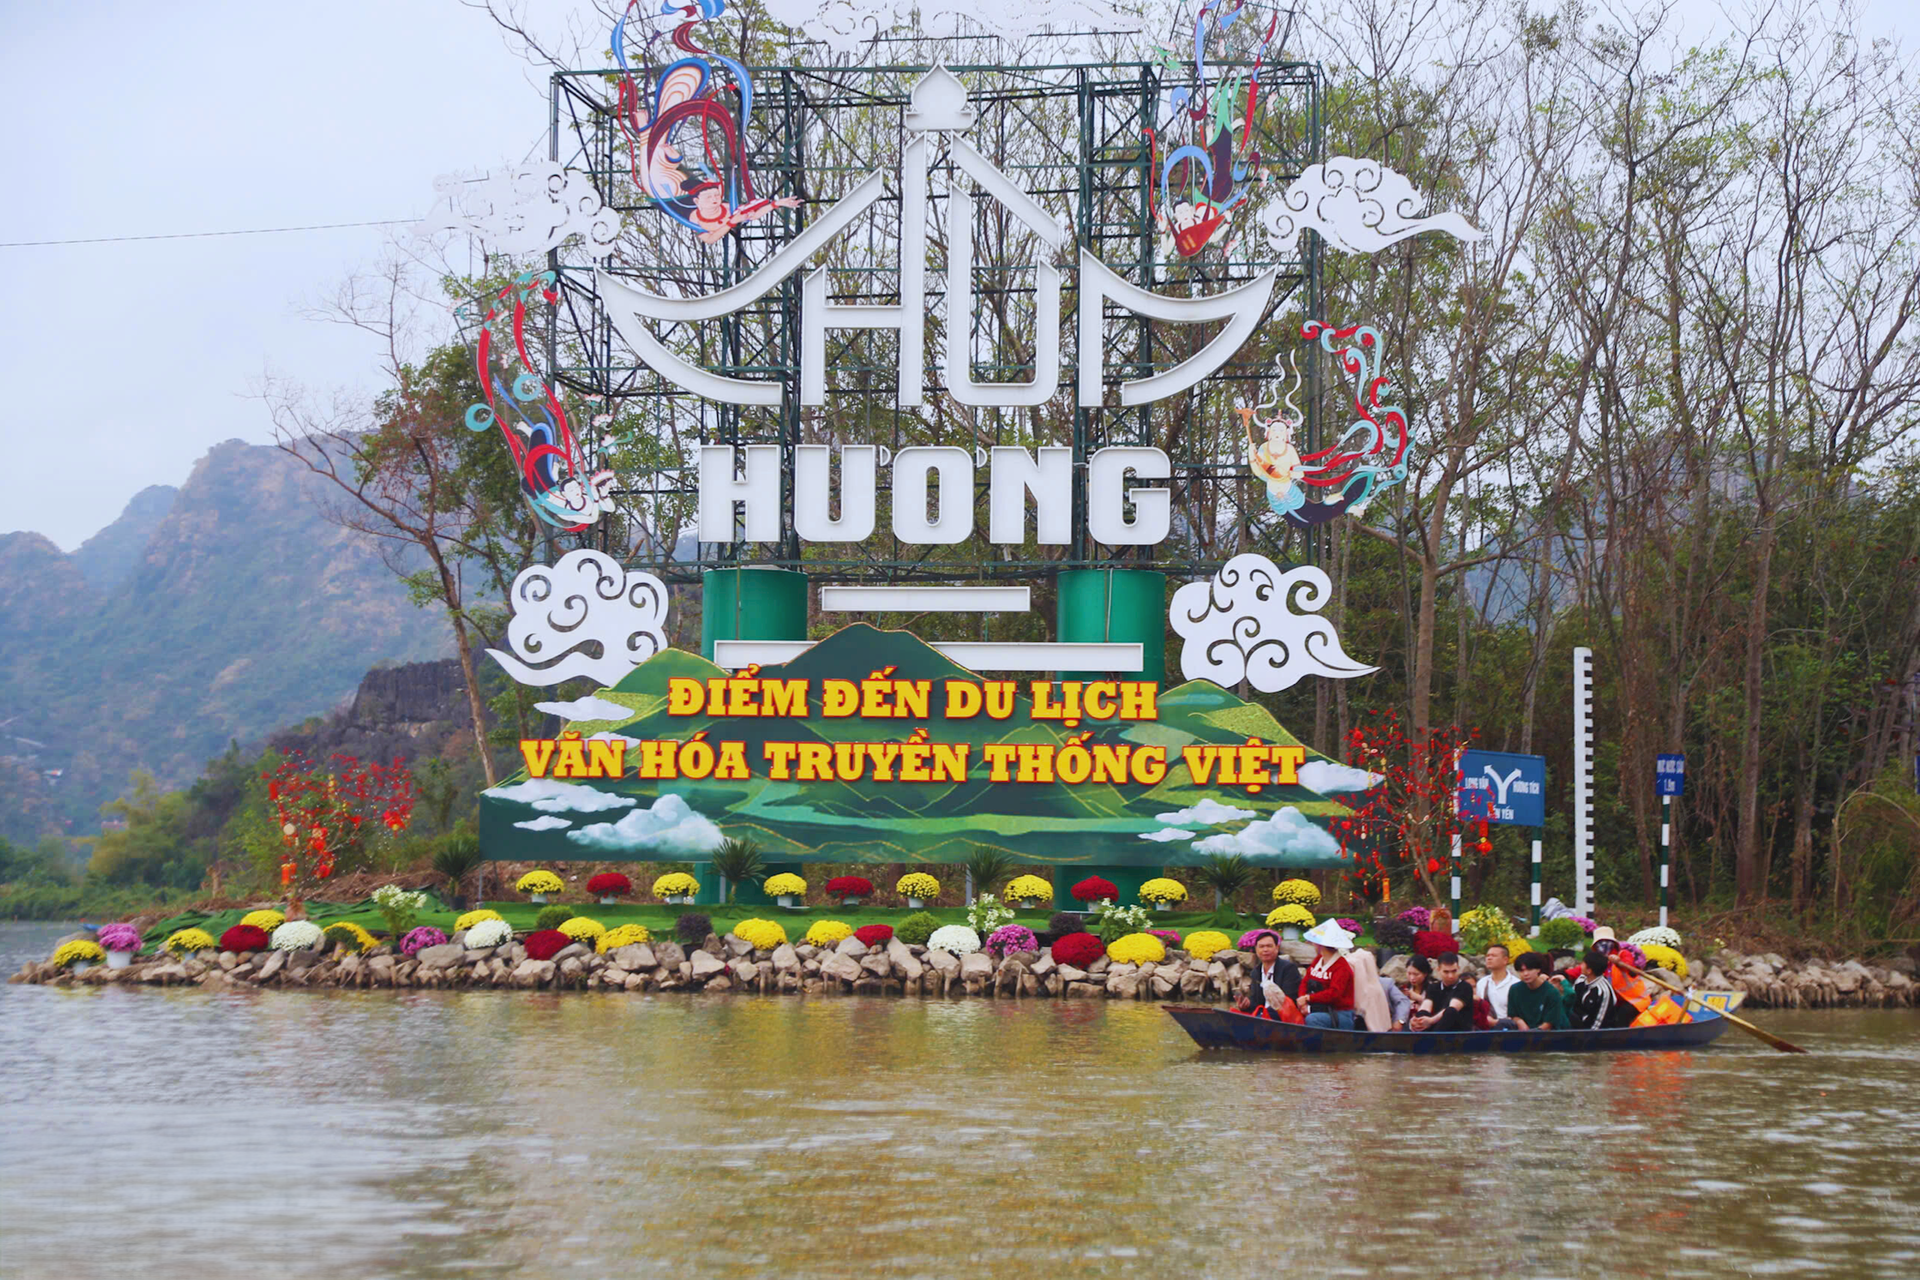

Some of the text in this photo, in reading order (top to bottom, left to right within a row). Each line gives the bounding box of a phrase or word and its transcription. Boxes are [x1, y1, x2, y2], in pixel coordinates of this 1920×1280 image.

[698, 443, 1171, 546] HƯƠNG
[667, 663, 1159, 728] ĐIỂM ĐẾN DU LỊCH
[519, 727, 1305, 793] VĂN HÓA TRUYỀN THỐNG VIỆT
